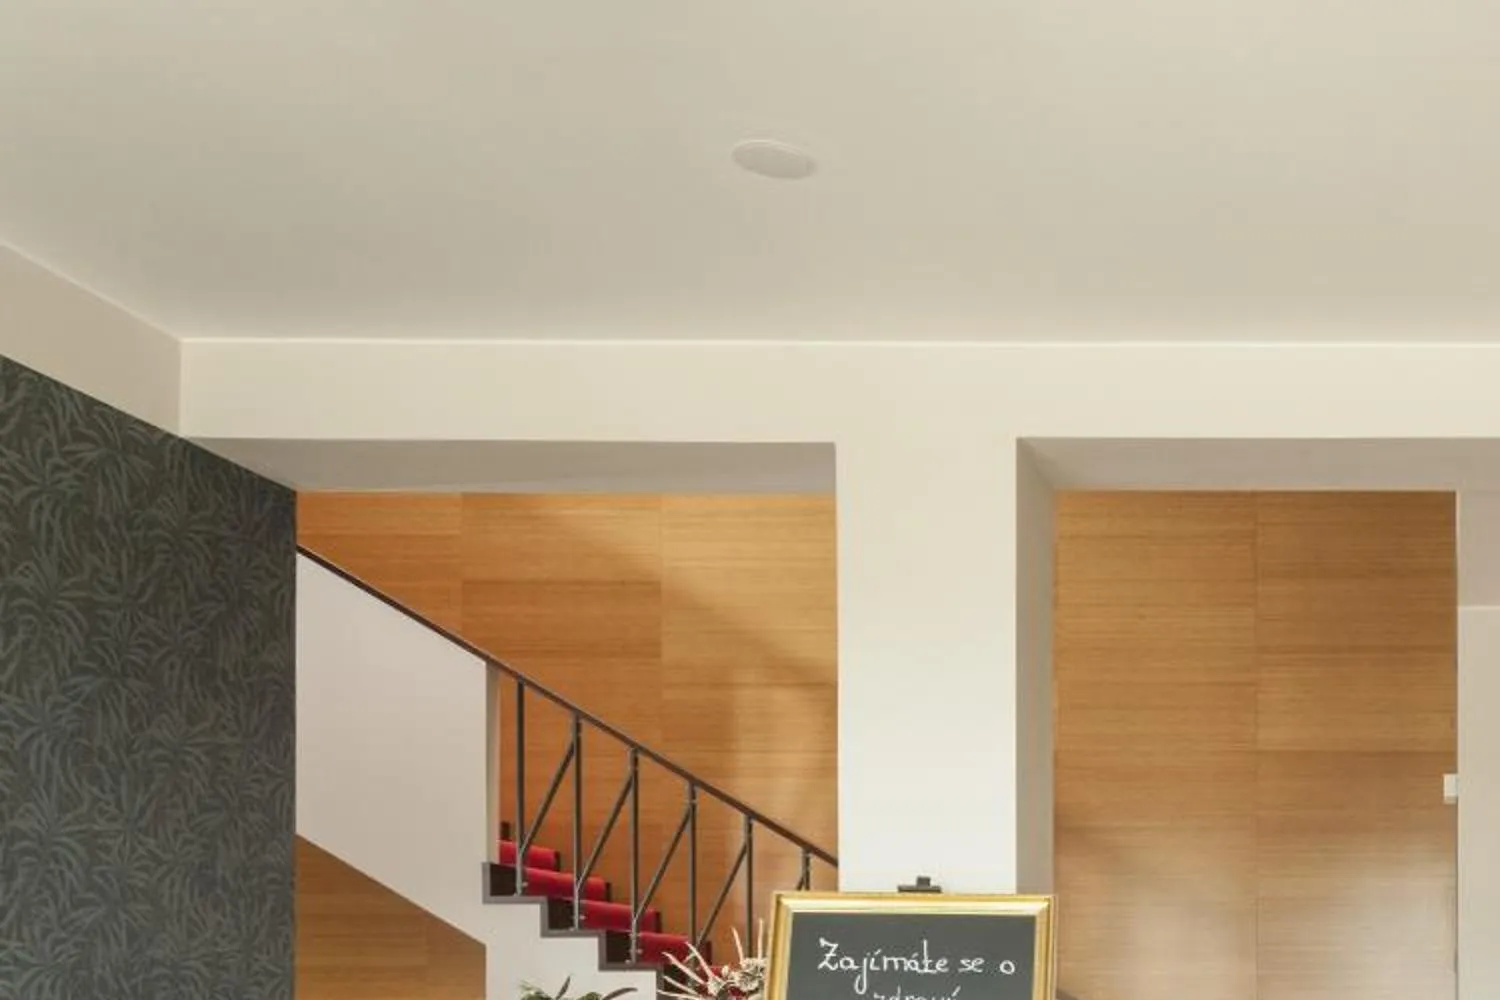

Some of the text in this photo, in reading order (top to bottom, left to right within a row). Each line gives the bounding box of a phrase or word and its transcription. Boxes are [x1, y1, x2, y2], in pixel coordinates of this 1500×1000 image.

[817, 936, 1017, 994] Zajímáte se o
